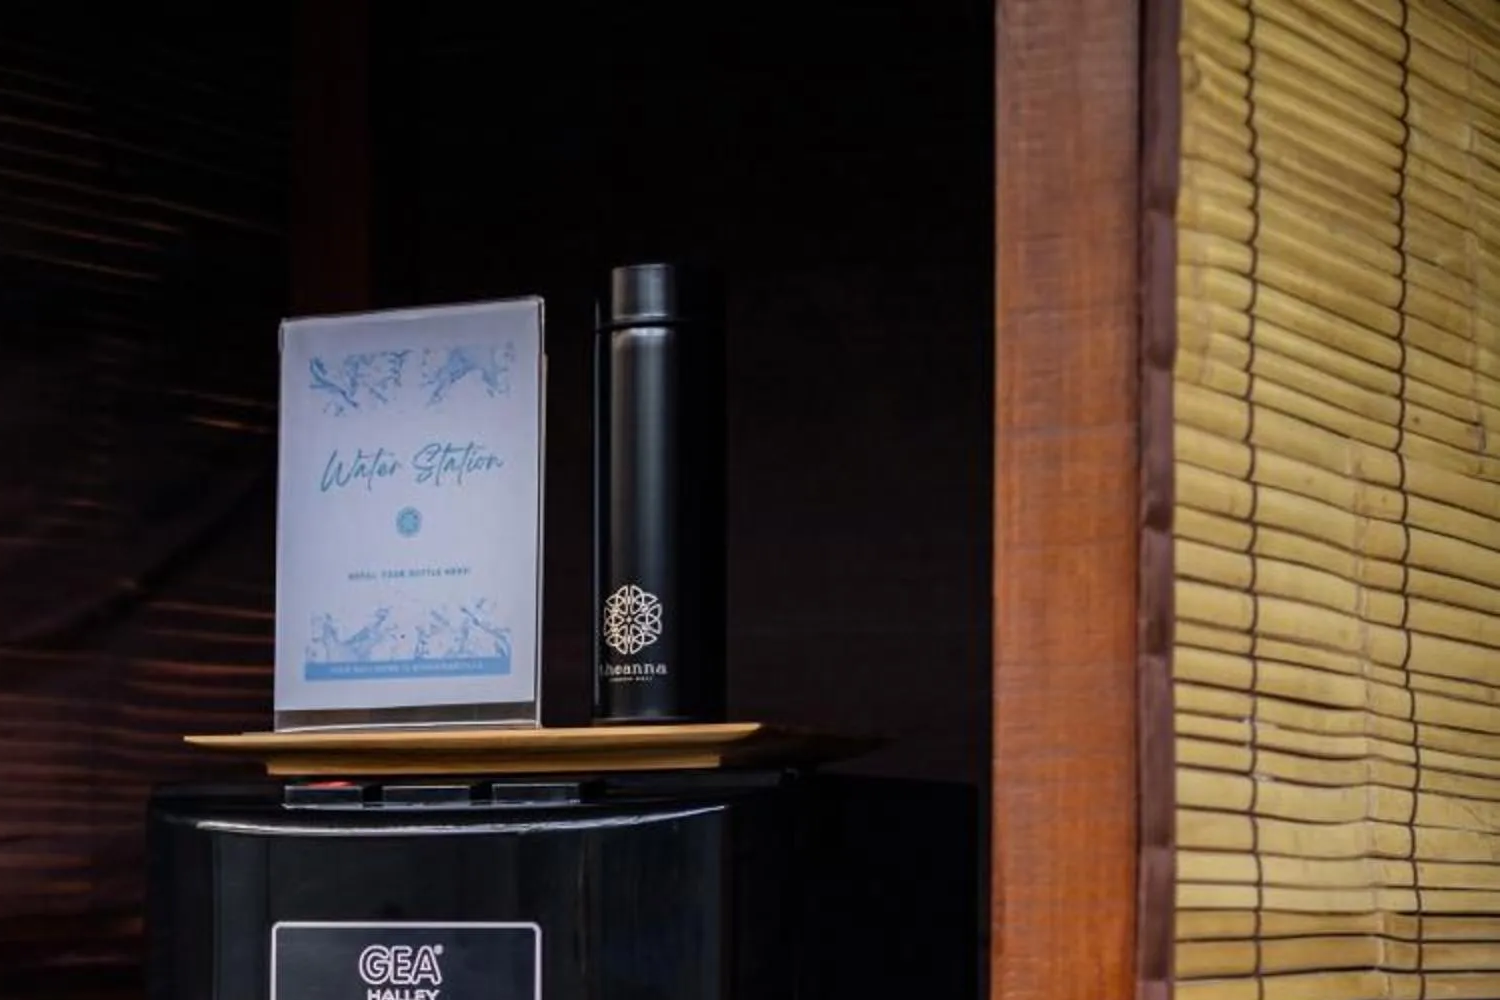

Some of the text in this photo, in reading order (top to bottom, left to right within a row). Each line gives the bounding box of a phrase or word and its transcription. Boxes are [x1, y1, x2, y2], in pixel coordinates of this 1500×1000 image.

[320, 441, 505, 492] Water Station
[409, 567, 442, 578] BOTTLE
